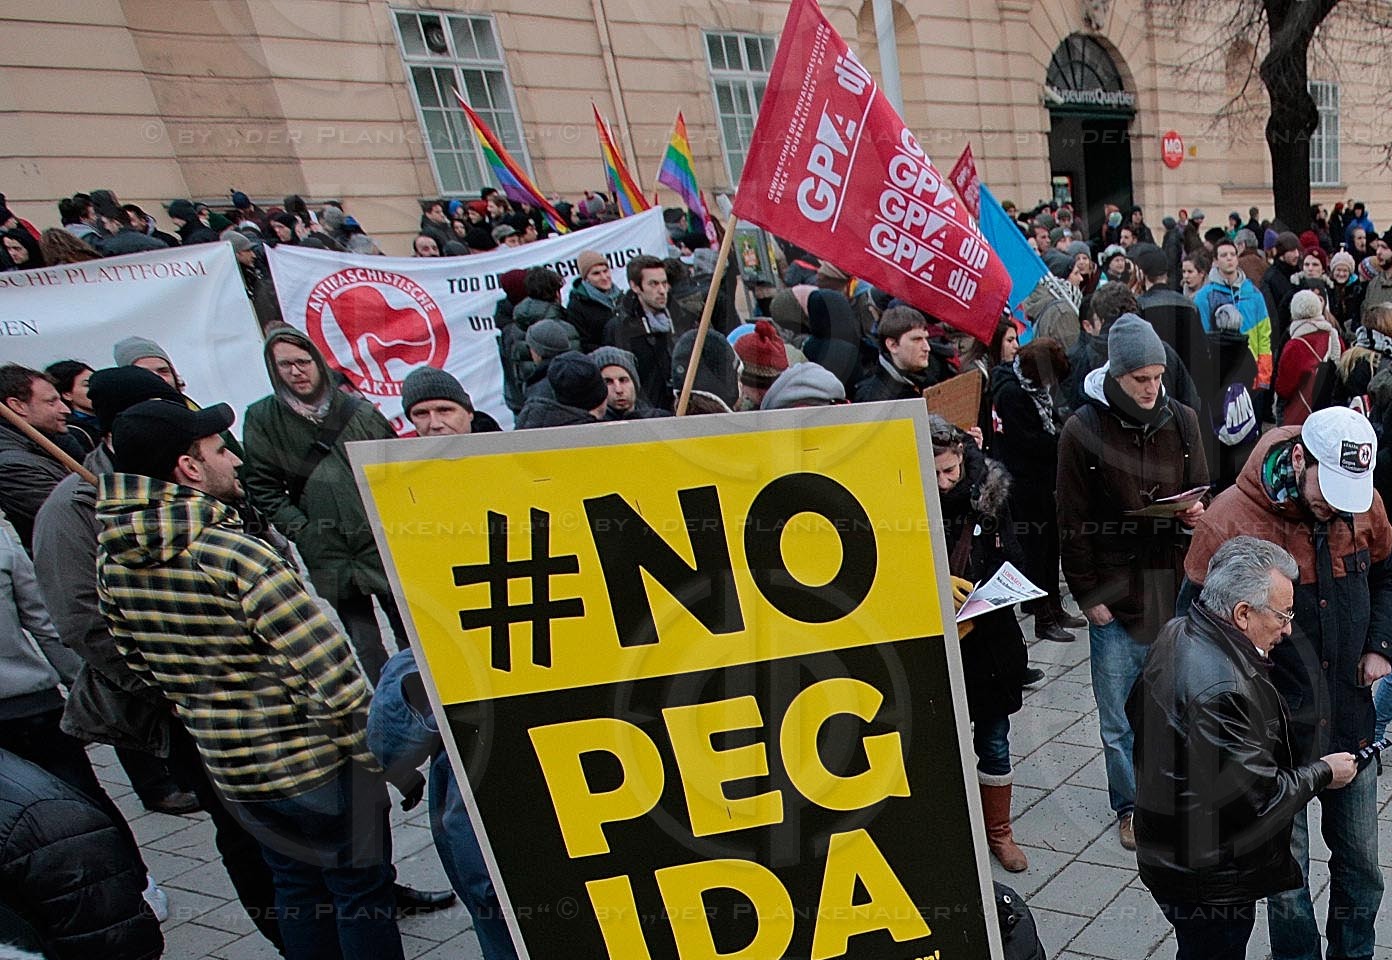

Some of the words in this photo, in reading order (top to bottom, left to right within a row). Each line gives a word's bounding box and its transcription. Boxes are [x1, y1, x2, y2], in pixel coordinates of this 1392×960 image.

[774, 172, 790, 204] DRUCK
[789, 79, 817, 158] JOURNALISMUS
[817, 27, 832, 65] PAPIER
[65, 261, 208, 284] PLATTFORM
[308, 268, 437, 312] ANTIFASCHISTISCHE
[447, 277, 480, 294] TOD
[452, 471, 878, 672] #NO
[528, 678, 911, 859] PEG
